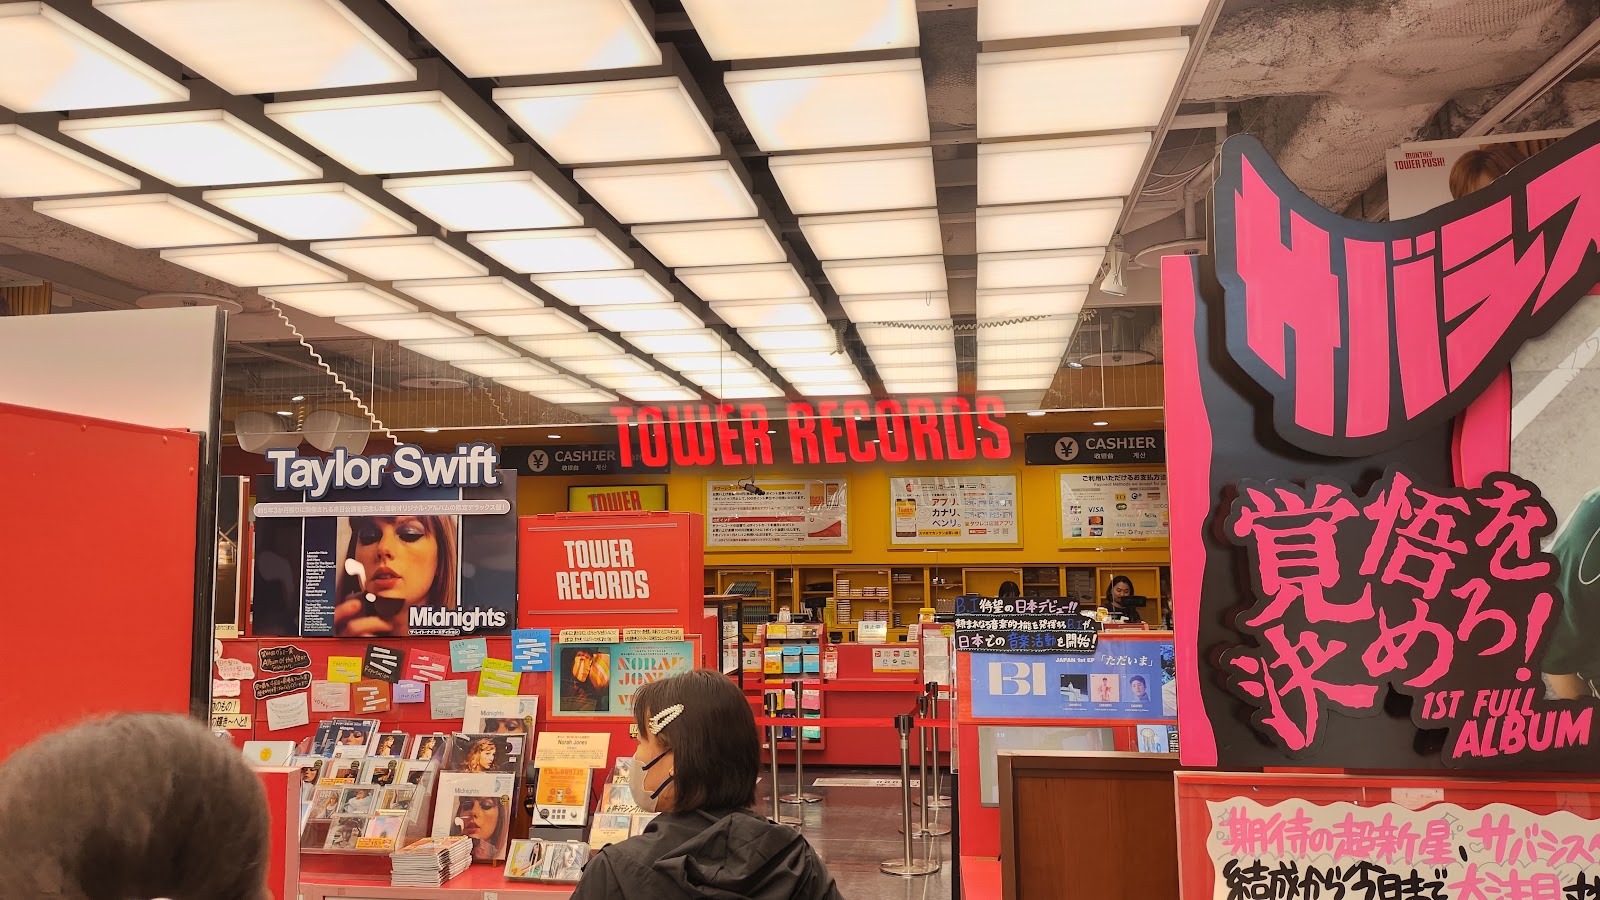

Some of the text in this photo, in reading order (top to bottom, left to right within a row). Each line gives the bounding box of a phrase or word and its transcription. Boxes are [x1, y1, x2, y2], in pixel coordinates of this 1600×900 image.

[1394, 157, 1446, 170] TOWER PUSH!
[1405, 151, 1433, 159] MONTHLY
[610, 396, 1012, 467] TOWER RECORDS
[1085, 436, 1157, 450] CASHIER
[554, 450, 616, 462] CASHIER
[267, 446, 497, 497] Taylor Swift
[588, 490, 643, 511] TOWER
[563, 539, 635, 569] TOWER
[1234, 472, 1550, 626] 覚悟を
[556, 570, 650, 600] RECORDS
[409, 606, 506, 632] Midnights
[1101, 654, 1154, 667] 「ただいま」
[1421, 687, 1536, 720] 1ST FULL
[1452, 707, 1593, 759] ALBUM
[1219, 806, 1600, 866] 期待の超新星、サバシス
